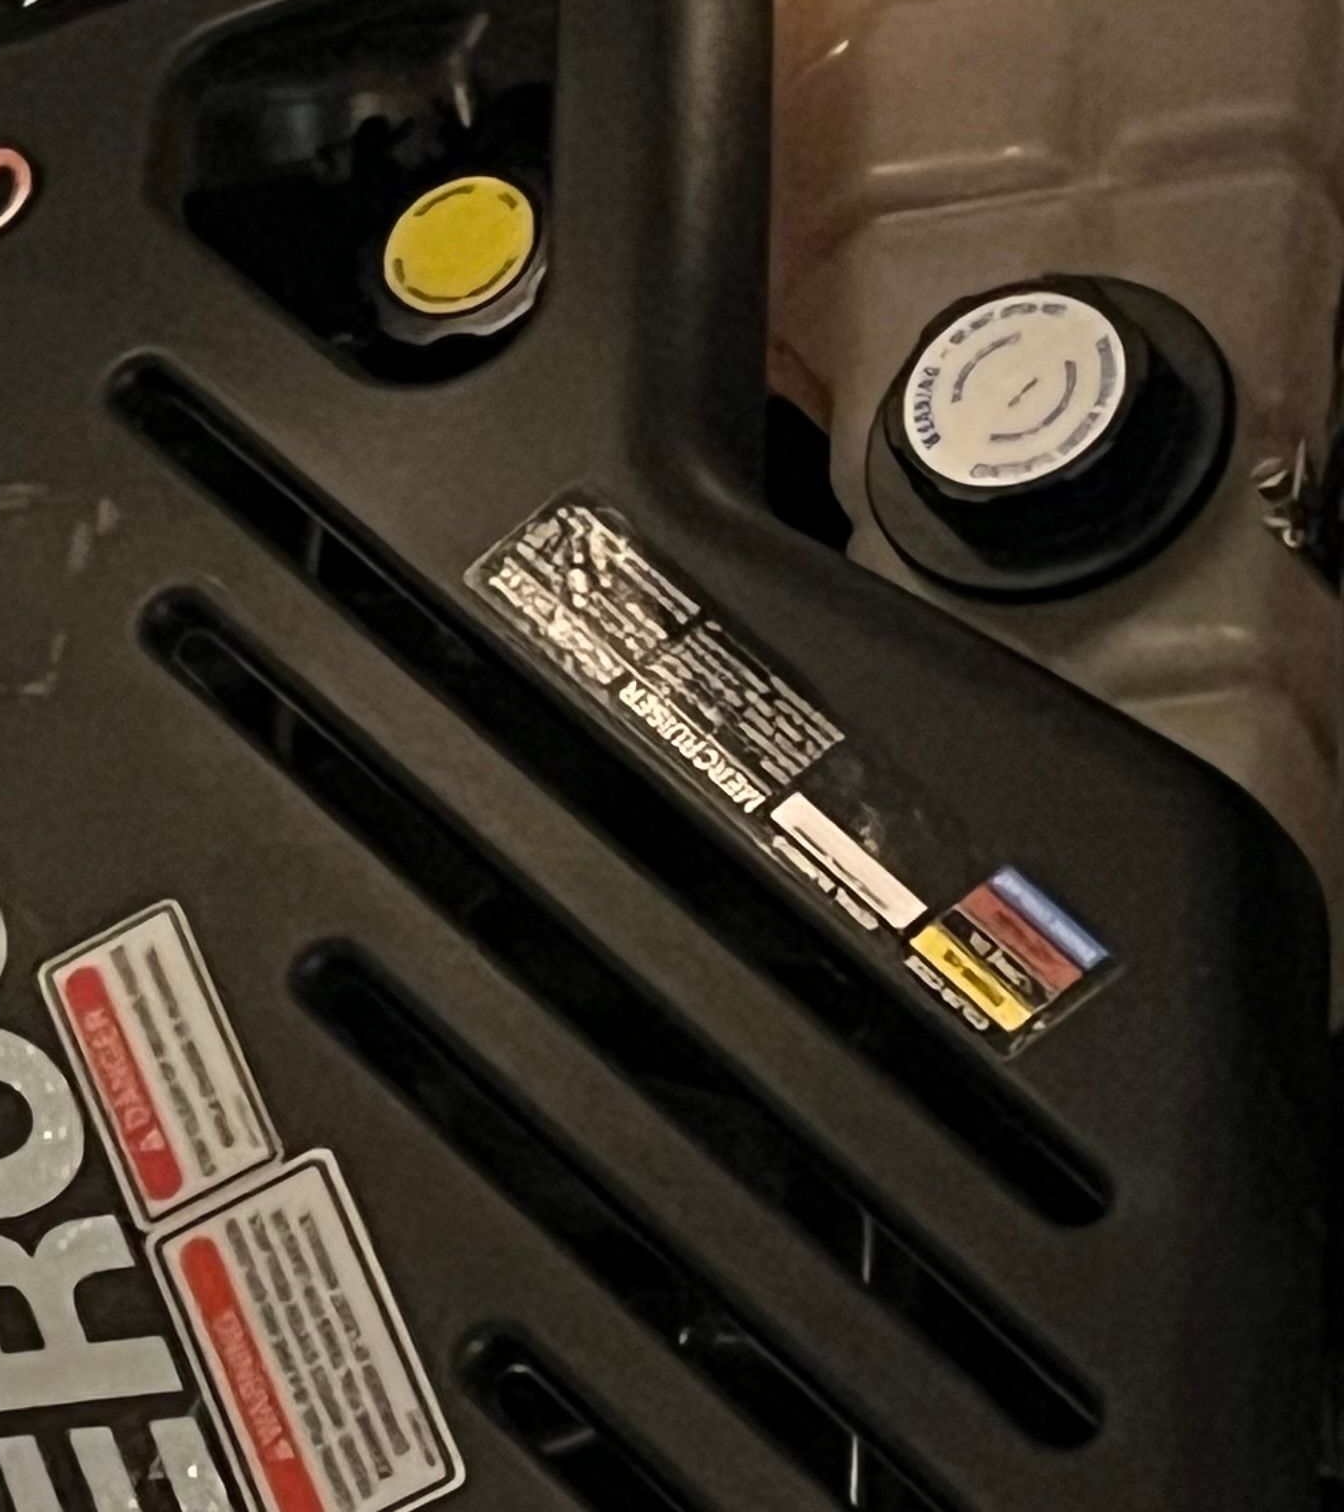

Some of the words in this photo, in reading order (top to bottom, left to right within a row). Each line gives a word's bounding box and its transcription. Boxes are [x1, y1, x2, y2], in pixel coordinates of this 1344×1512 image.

[618, 680, 766, 813] MERCRUISER
[82, 1009, 151, 1130] DANGER
[212, 1308, 284, 1444] WARNING
